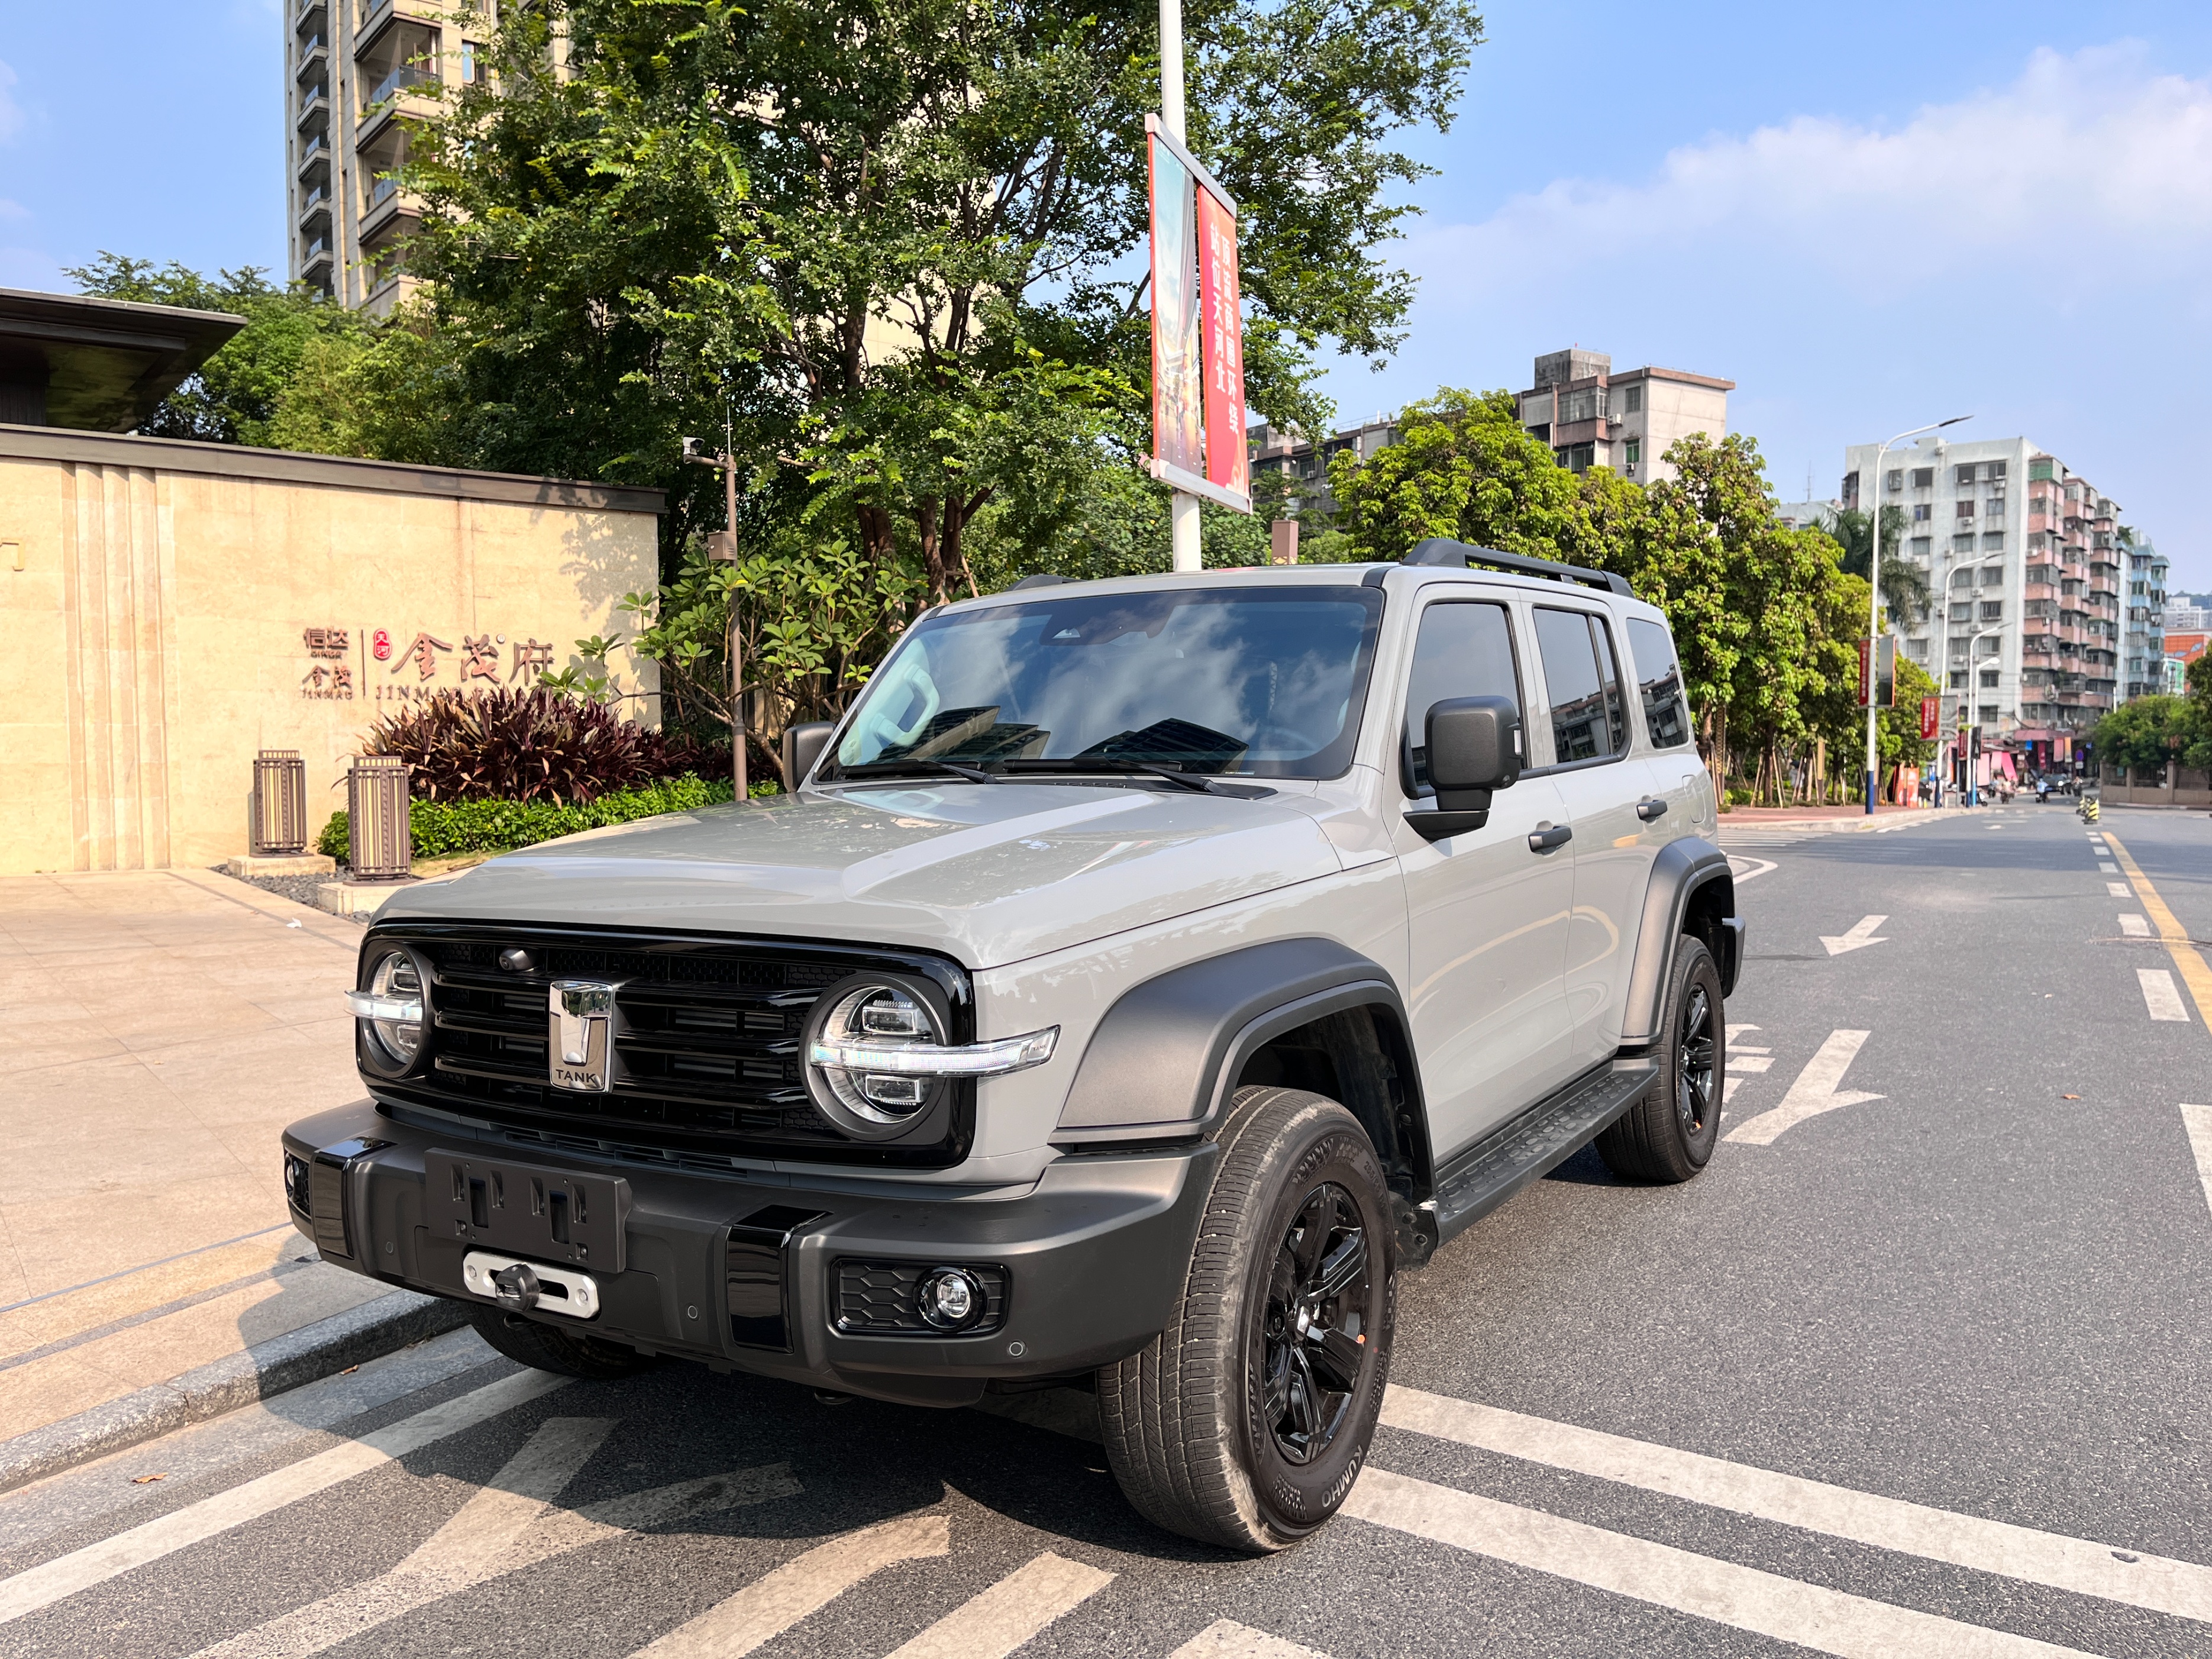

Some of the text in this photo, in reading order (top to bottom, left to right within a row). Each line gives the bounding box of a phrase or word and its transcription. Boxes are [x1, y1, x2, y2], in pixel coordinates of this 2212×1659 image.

[1210, 222, 1226, 393] 站位天河北
[303, 628, 349, 650] 信达
[376, 633, 389, 656] 天河
[391, 632, 555, 686] 金茂府
[302, 666, 352, 689] 金茂
[556, 1069, 596, 1083] TANK
[1322, 1444, 1363, 1508] KUMHO
